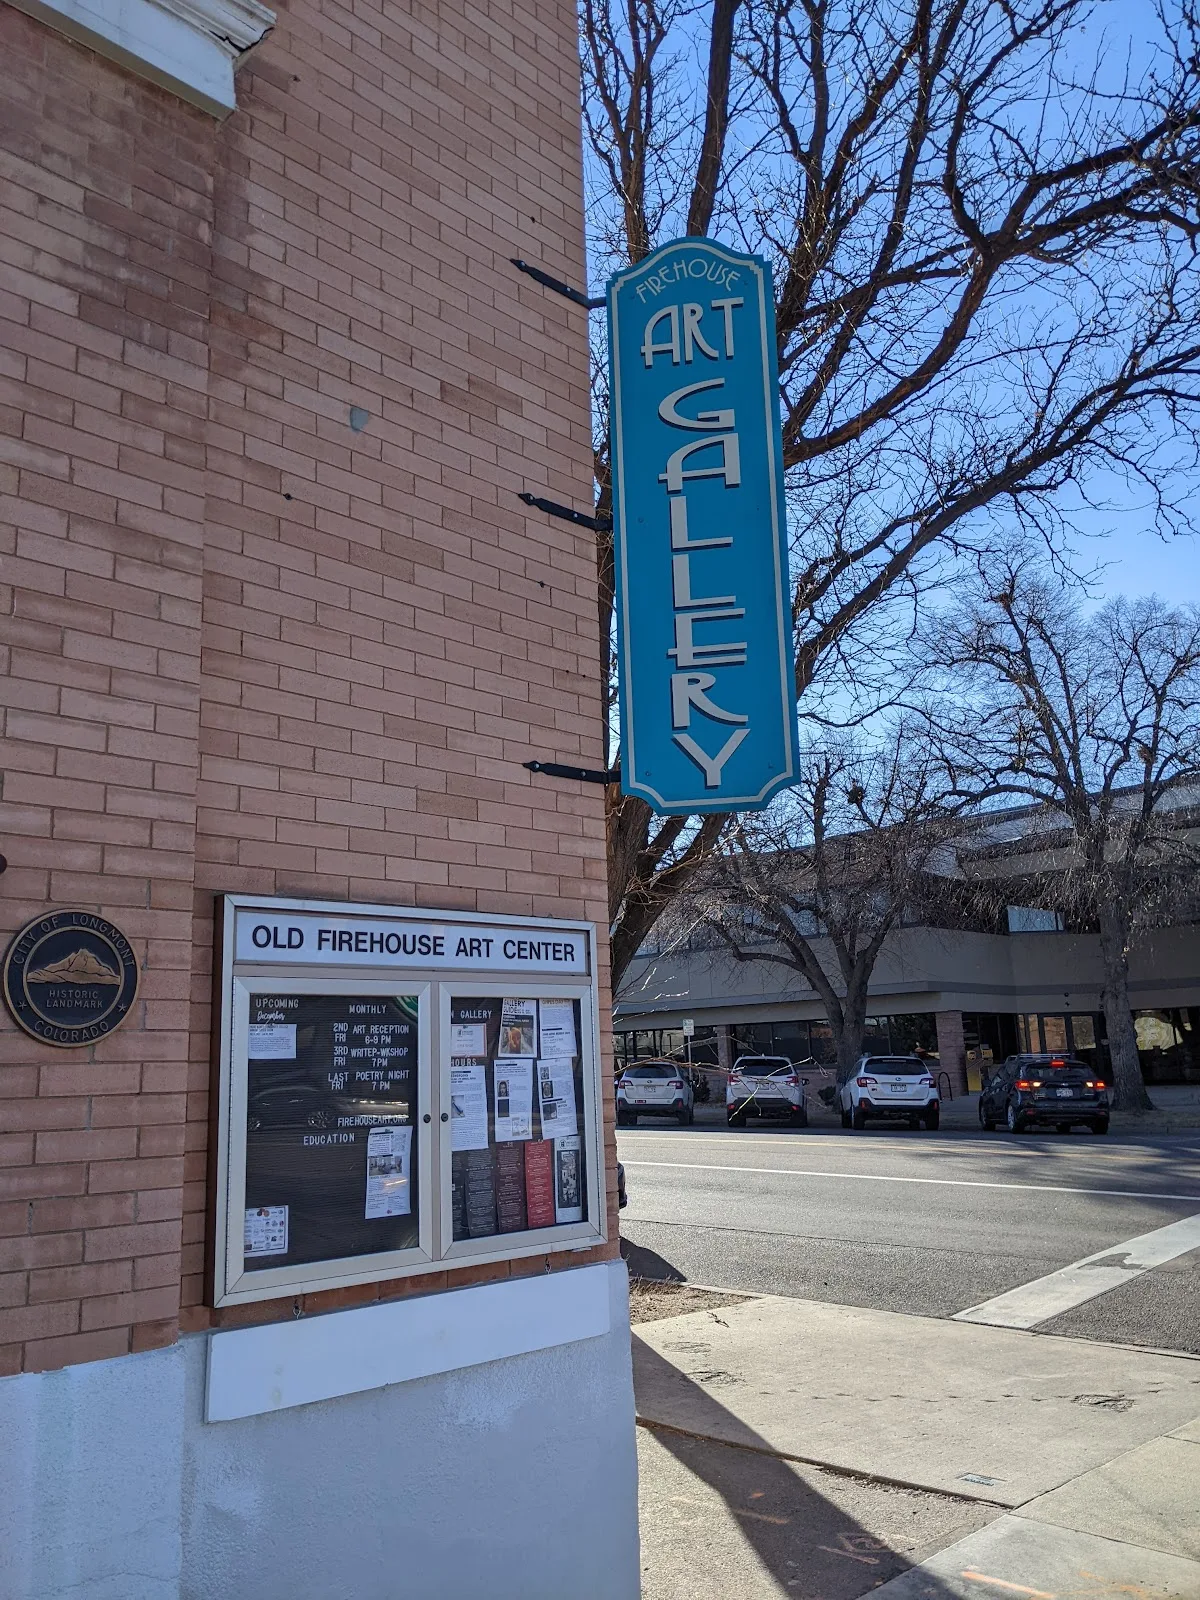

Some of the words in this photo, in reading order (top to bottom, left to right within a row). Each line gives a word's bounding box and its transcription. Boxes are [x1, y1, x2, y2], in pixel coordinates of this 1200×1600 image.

[636, 258, 741, 303] FIREHOUSE
[640, 296, 744, 367] ART
[658, 377, 751, 788] GALLERY
[13, 932, 36, 964] CITY
[40, 916, 60, 931] OF
[72, 913, 136, 966] LONGMONT
[252, 924, 304, 949] OLD
[317, 929, 445, 955] FIREHOUSE
[455, 937, 494, 958] ART
[503, 939, 575, 962] CENTER
[49, 989, 99, 998] HISTORIC
[46, 999, 103, 1009] LANDMARK
[255, 998, 299, 1008] UPCOMING
[349, 1004, 387, 1014] MONTHLY
[460, 1009, 493, 1019] GALLERY
[34, 1020, 109, 1042] COLORADO
[333, 1022, 349, 1033] 2ND
[352, 1024, 366, 1034] ART
[370, 1024, 410, 1034] RECEPTION
[334, 1033, 347, 1043] FRI
[380, 1034, 392, 1045] PM
[333, 1045, 349, 1056] 3RD
[333, 1056, 346, 1067] FRI
[328, 1071, 349, 1082] LAST
[355, 1070, 385, 1081] POETRY
[388, 1069, 410, 1080] NIGHT
[331, 1080, 344, 1091] FRI
[303, 1132, 355, 1146] EDUCATION
